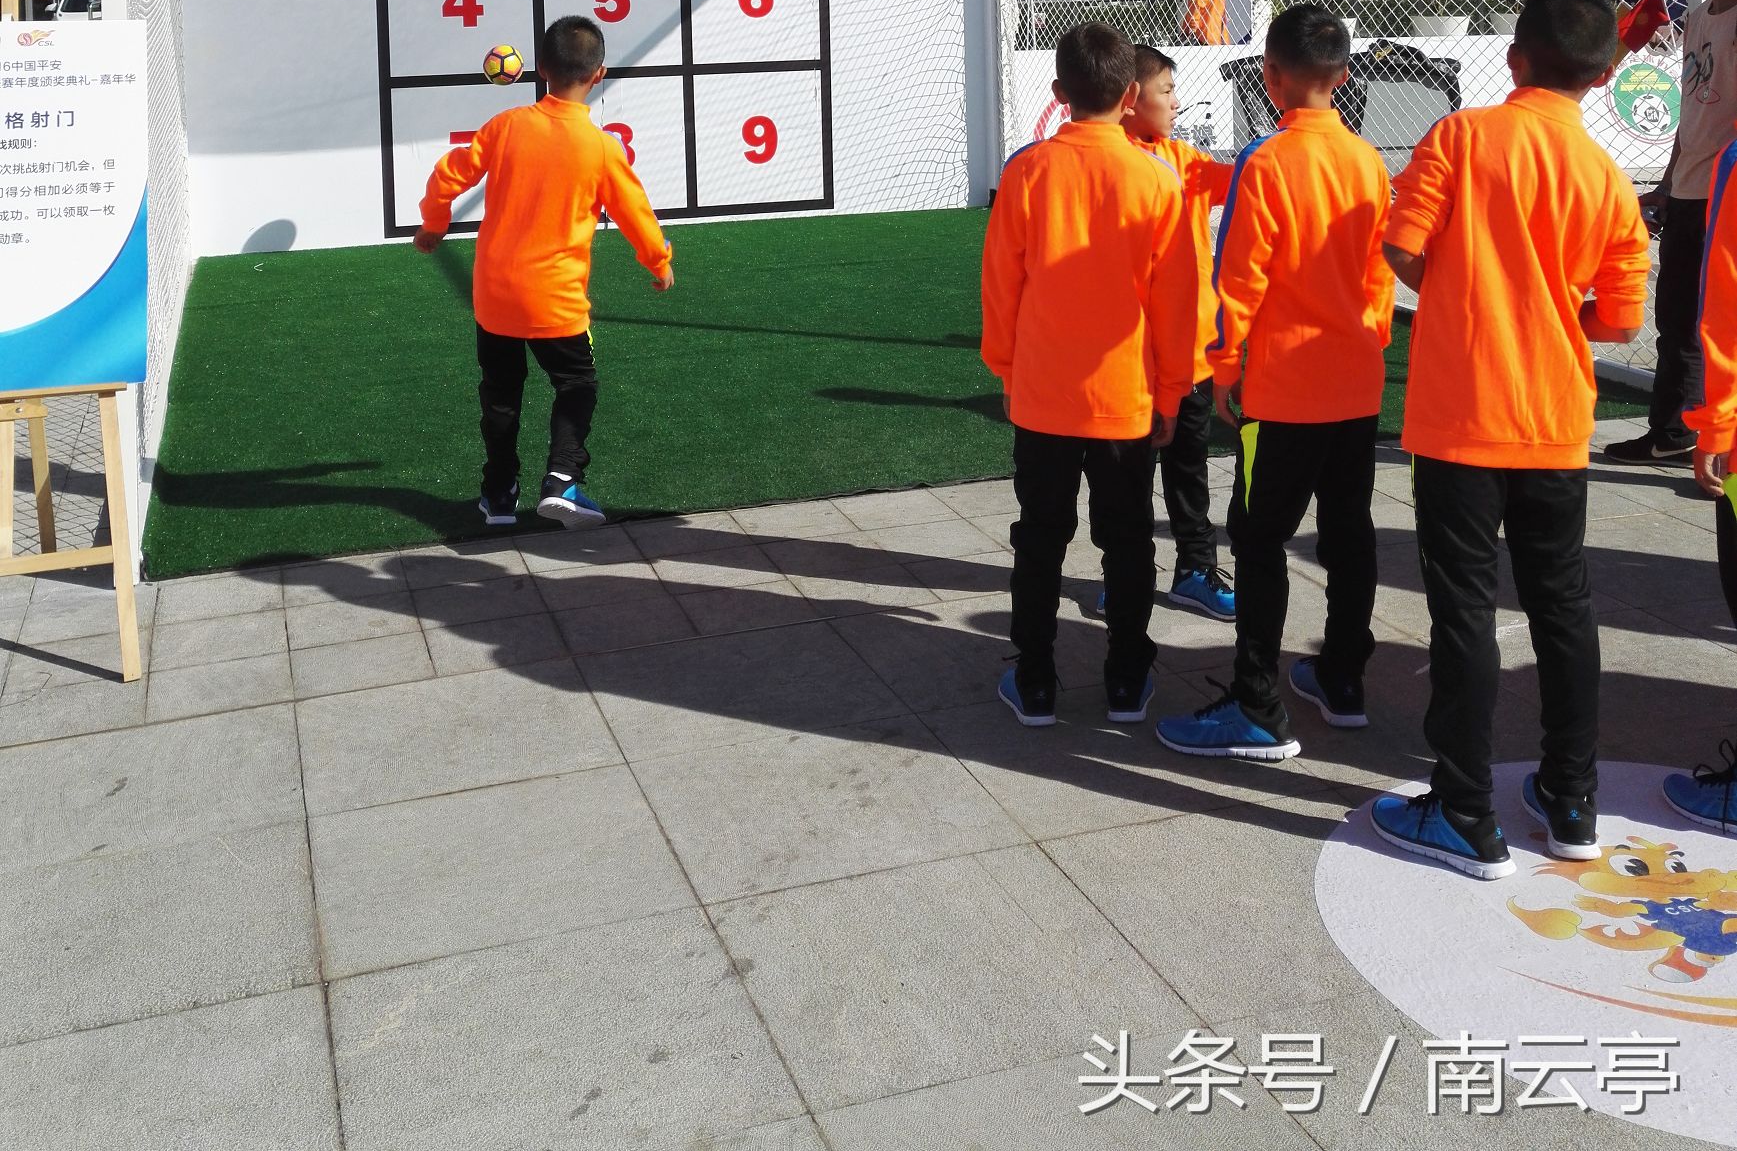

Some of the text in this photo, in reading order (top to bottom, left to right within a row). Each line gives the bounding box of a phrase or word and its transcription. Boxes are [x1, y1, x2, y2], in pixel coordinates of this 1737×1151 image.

[0, 73, 137, 89] 赛年度颁奖典礼-嘉年华
[741, 115, 778, 164] 9
[0, 181, 116, 199] 得分相加必须等于
